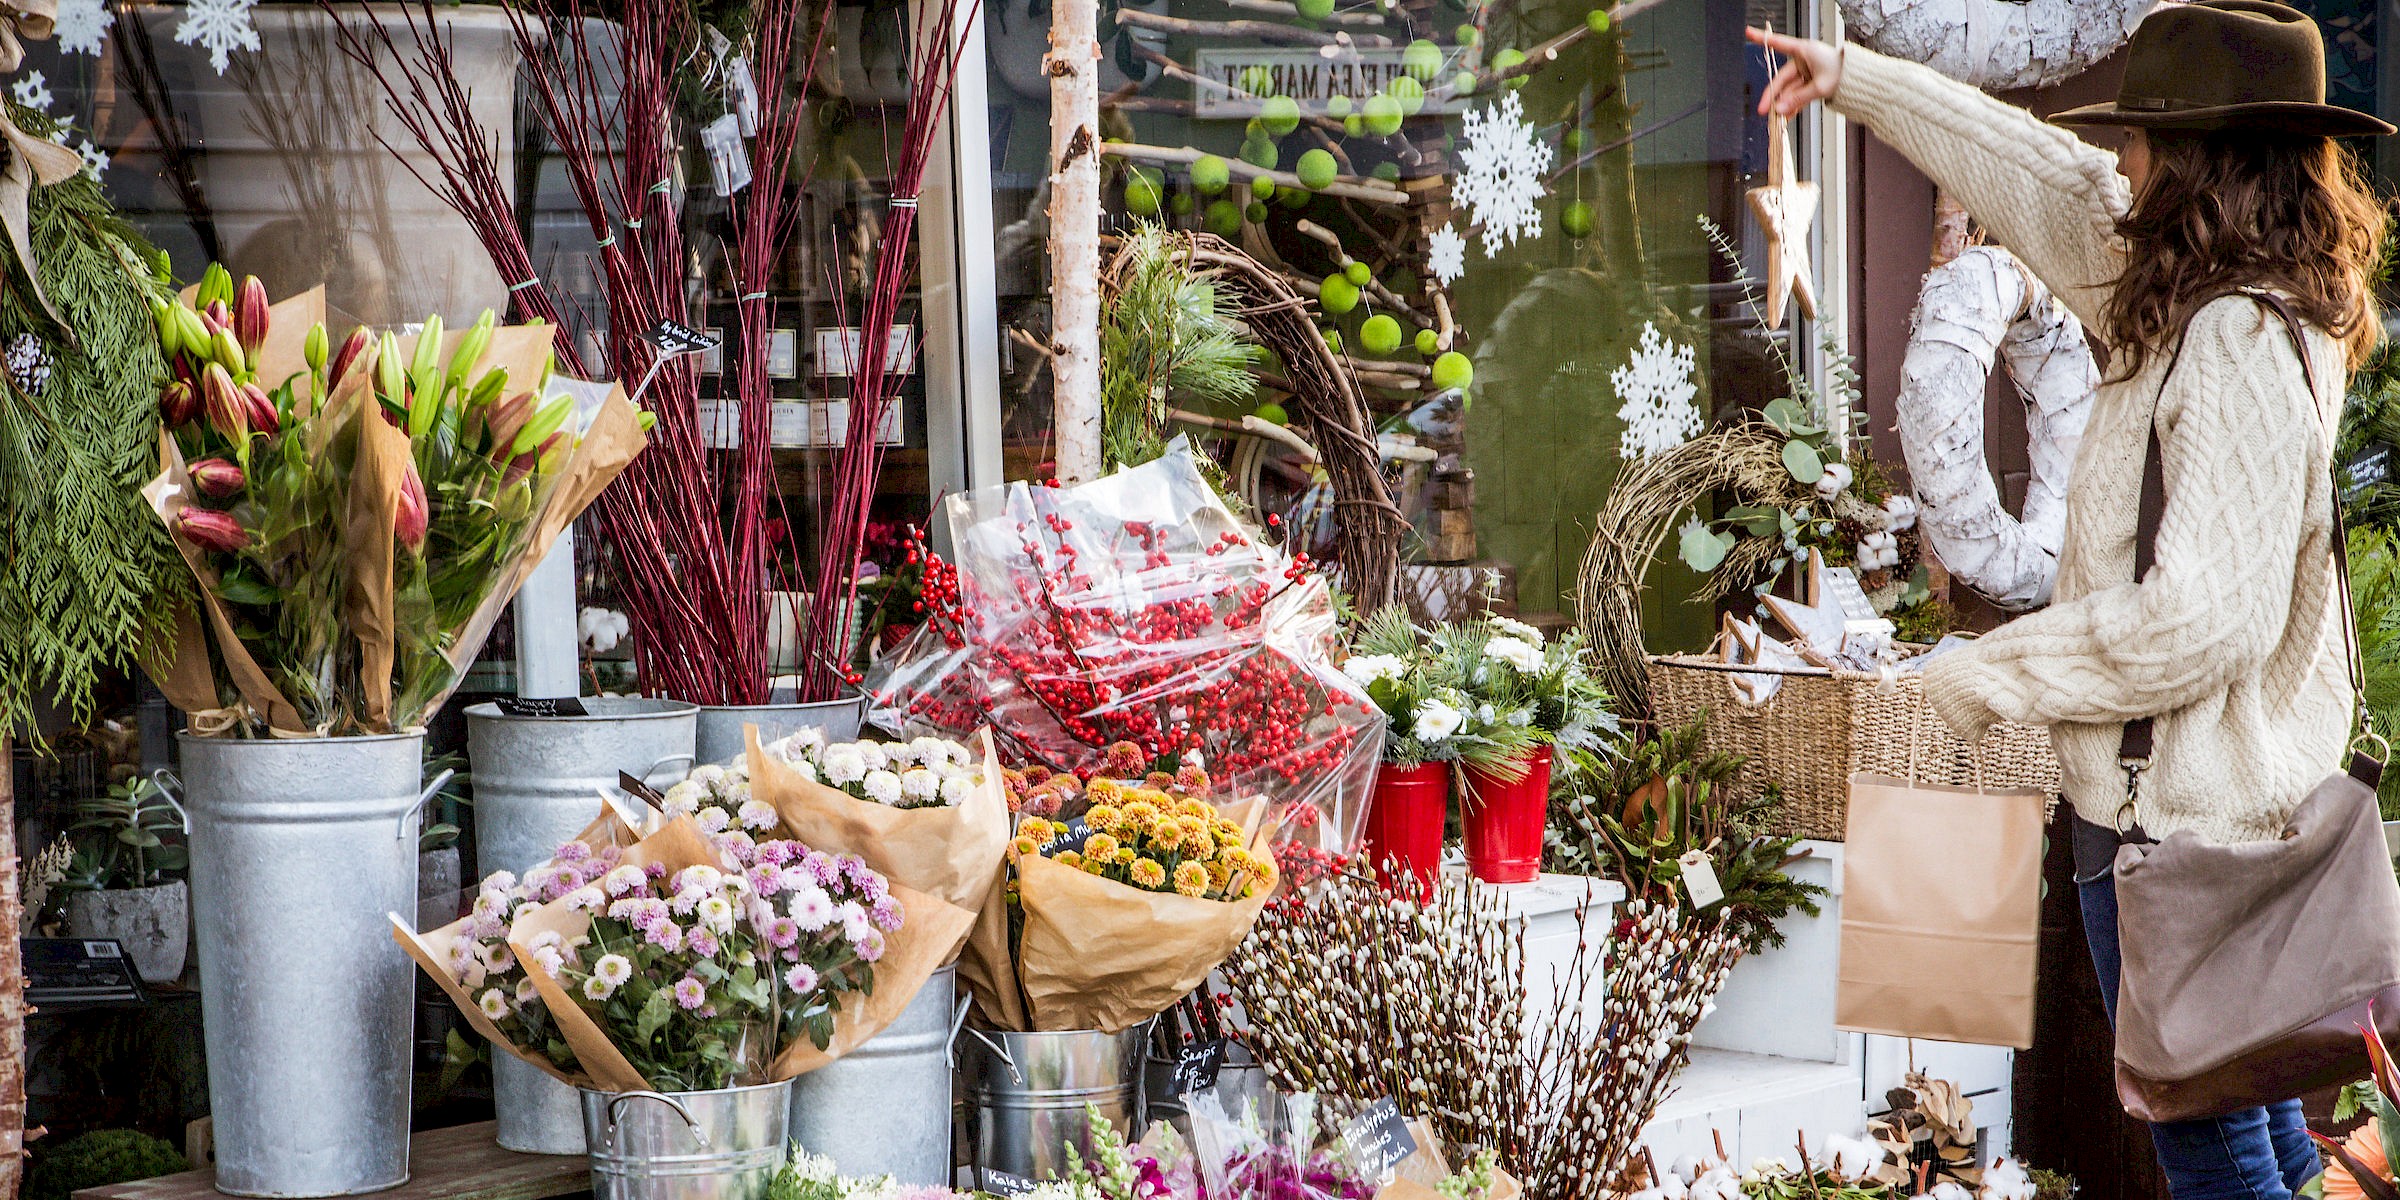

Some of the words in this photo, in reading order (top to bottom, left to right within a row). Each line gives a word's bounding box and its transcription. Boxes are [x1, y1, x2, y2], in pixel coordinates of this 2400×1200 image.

[661, 319, 690, 341] Hybrid
[516, 697, 557, 714] Happy
[1179, 1045, 1217, 1068] Snaps
[1342, 1103, 1397, 1152] Eucalyptus
[1358, 1129, 1392, 1159] bunches
[988, 1170, 1019, 1190] Kale
